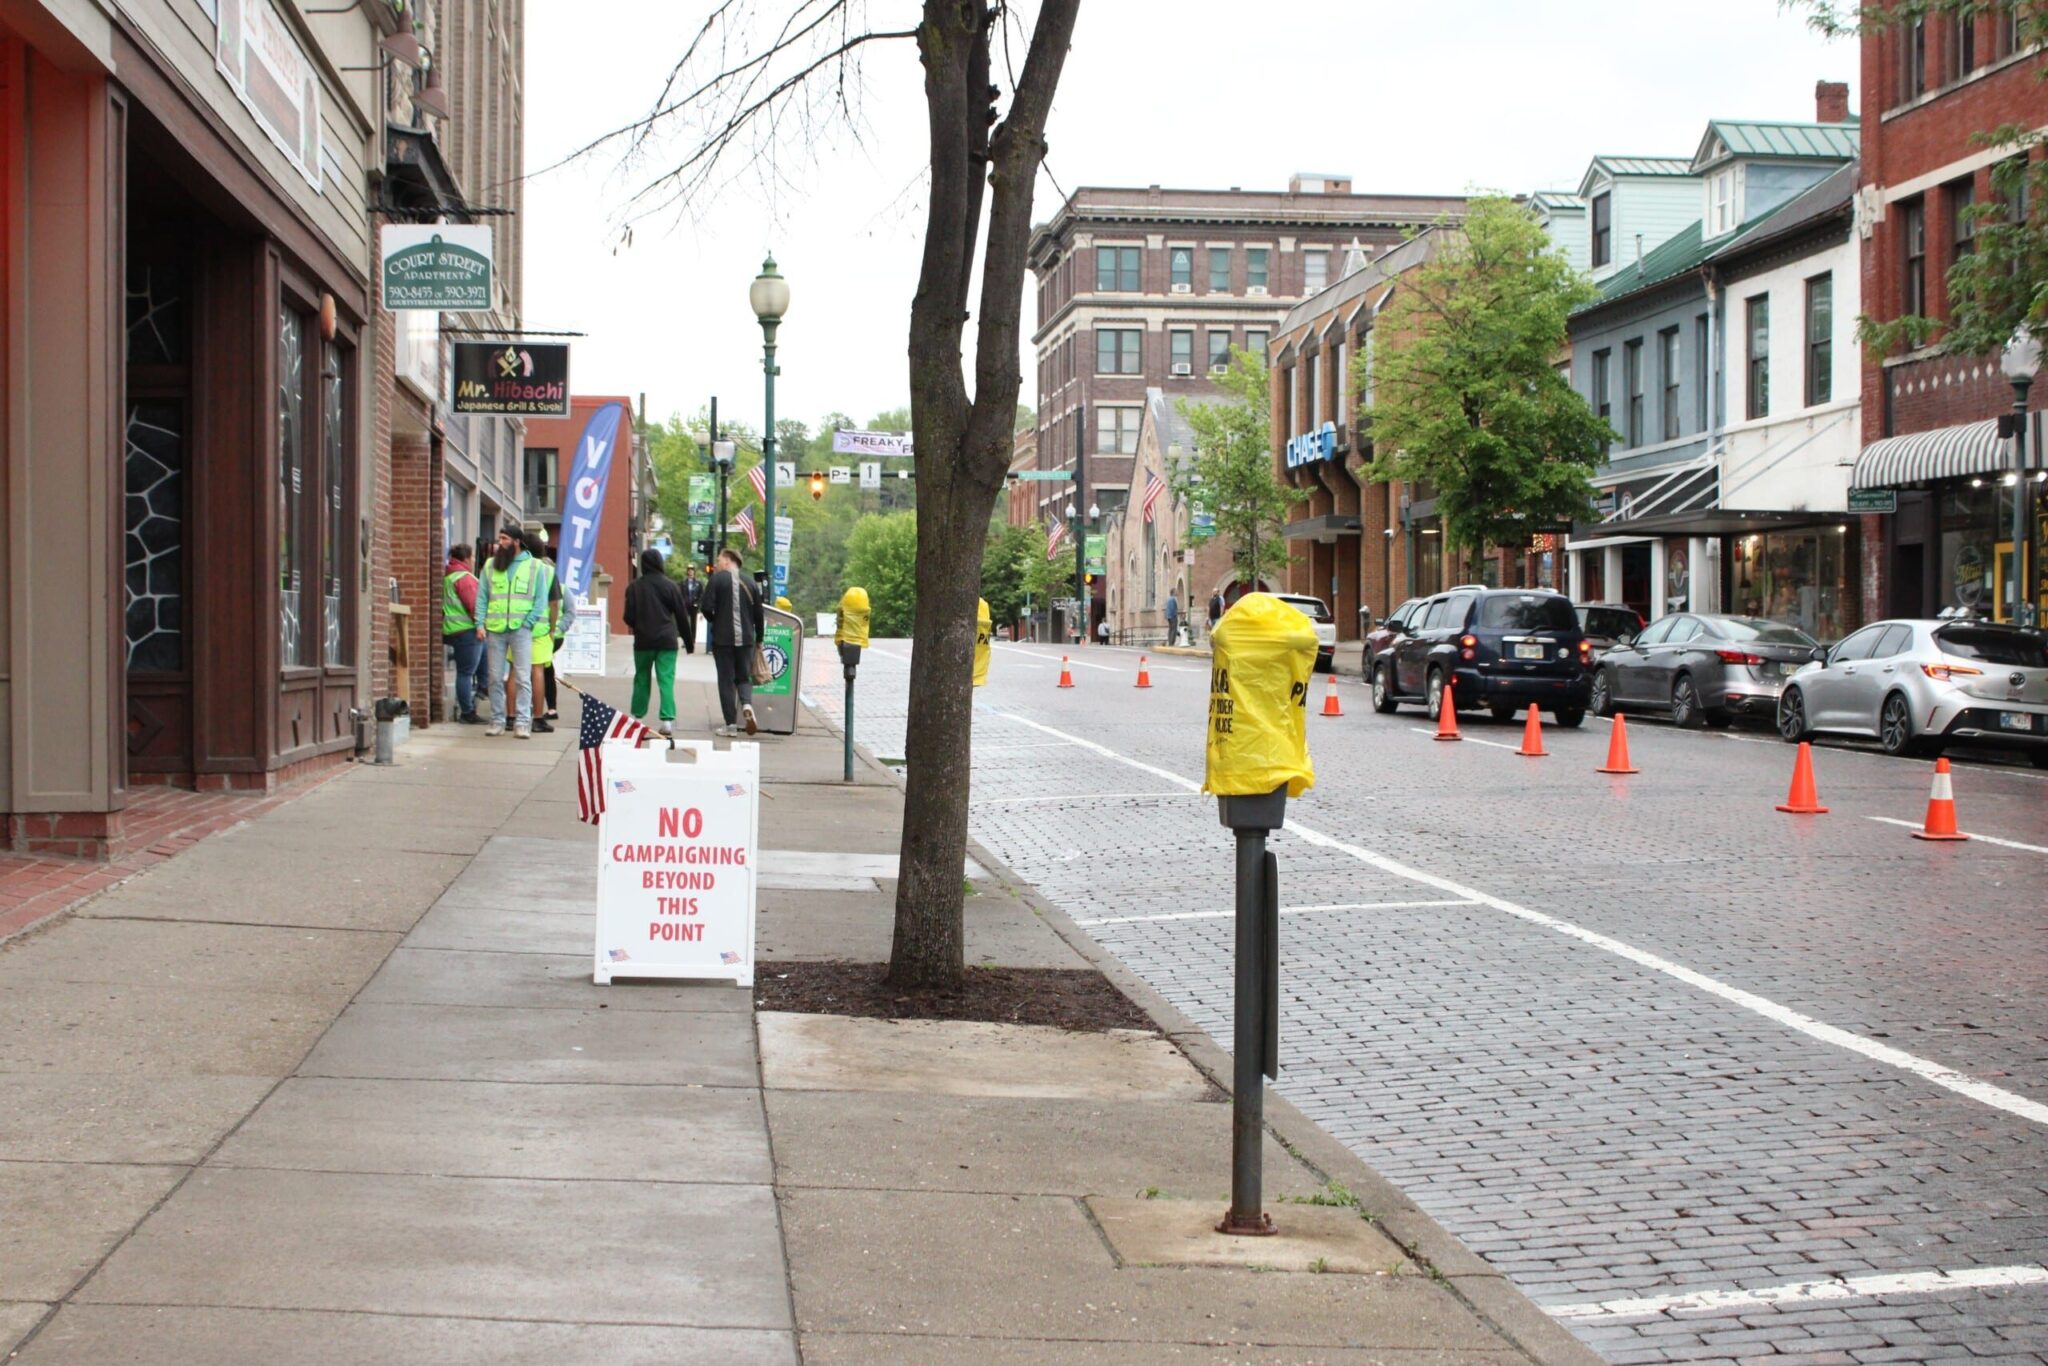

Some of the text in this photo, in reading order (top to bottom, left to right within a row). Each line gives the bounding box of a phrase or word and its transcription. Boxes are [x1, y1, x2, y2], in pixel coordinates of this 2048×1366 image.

[389, 252, 485, 276] COURT STREET
[404, 271, 471, 280] APARTMENTS
[389, 286, 432, 299] 590-8455
[445, 286, 486, 298] 590-3971
[458, 381, 564, 399] Mr. Hibachi
[457, 401, 563, 412] Japanese Grill & Sushi
[853, 436, 903, 448] FREAKY
[1287, 429, 1323, 468] CHASE
[832, 470, 840, 480] P
[565, 436, 607, 590] VOTE
[658, 808, 703, 838] NO
[613, 844, 745, 866] CAMPAIGNING
[642, 871, 715, 890] BEYOND
[657, 897, 698, 916] THIS
[650, 923, 705, 942] POINT
